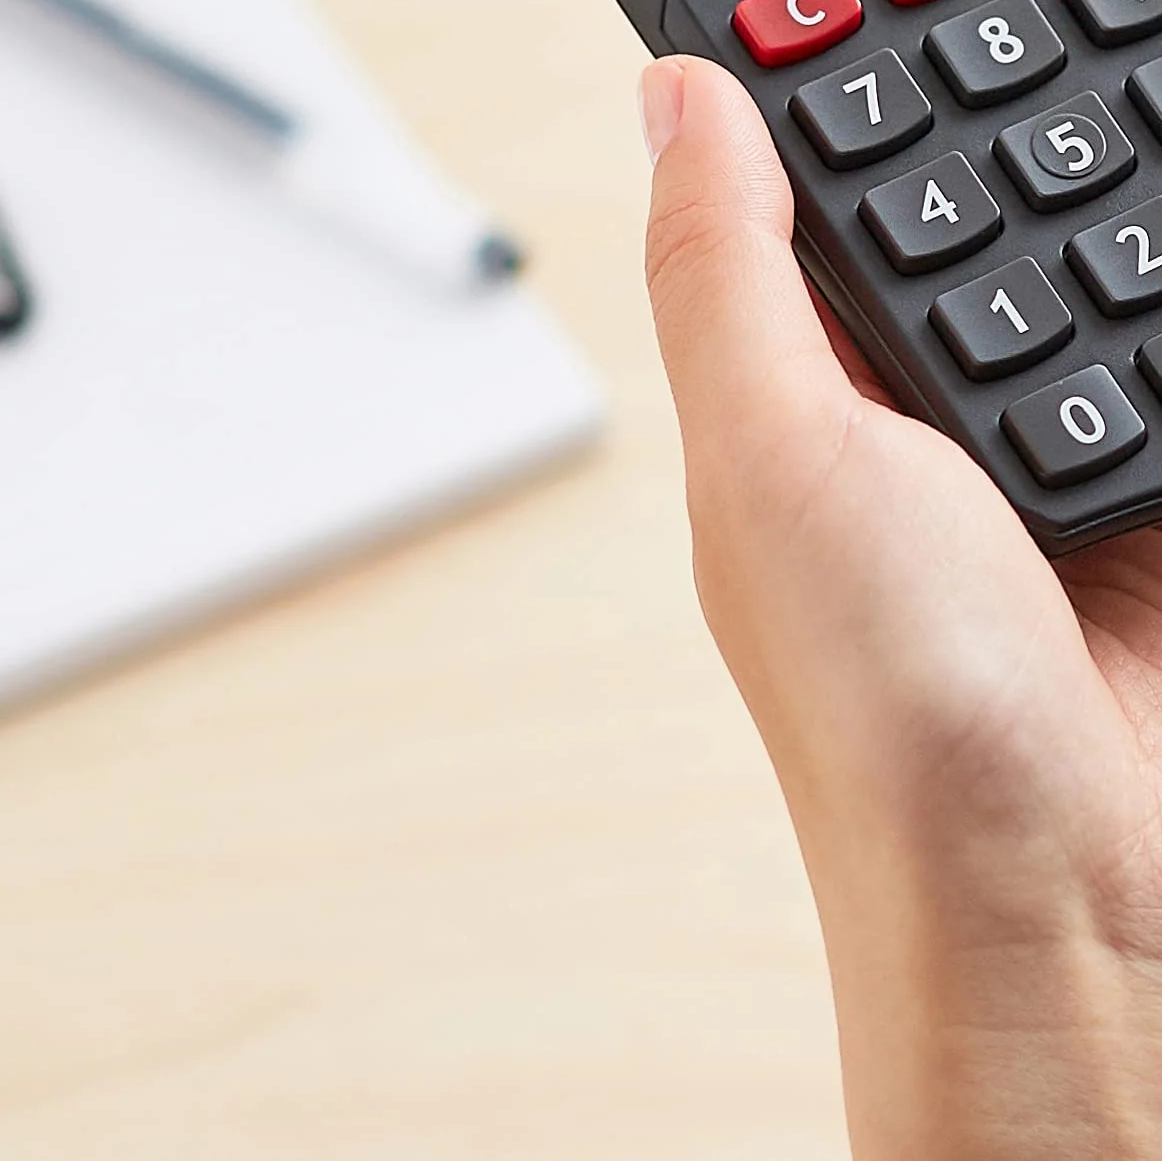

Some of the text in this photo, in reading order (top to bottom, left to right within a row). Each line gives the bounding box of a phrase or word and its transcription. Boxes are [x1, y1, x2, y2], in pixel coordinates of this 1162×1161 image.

[978, 16, 1025, 64] 8
[842, 71, 882, 125] 7
[1044, 121, 1095, 172] 5
[921, 179, 960, 224] 4
[989, 288, 1030, 334] 1
[1059, 396, 1106, 444] 0
